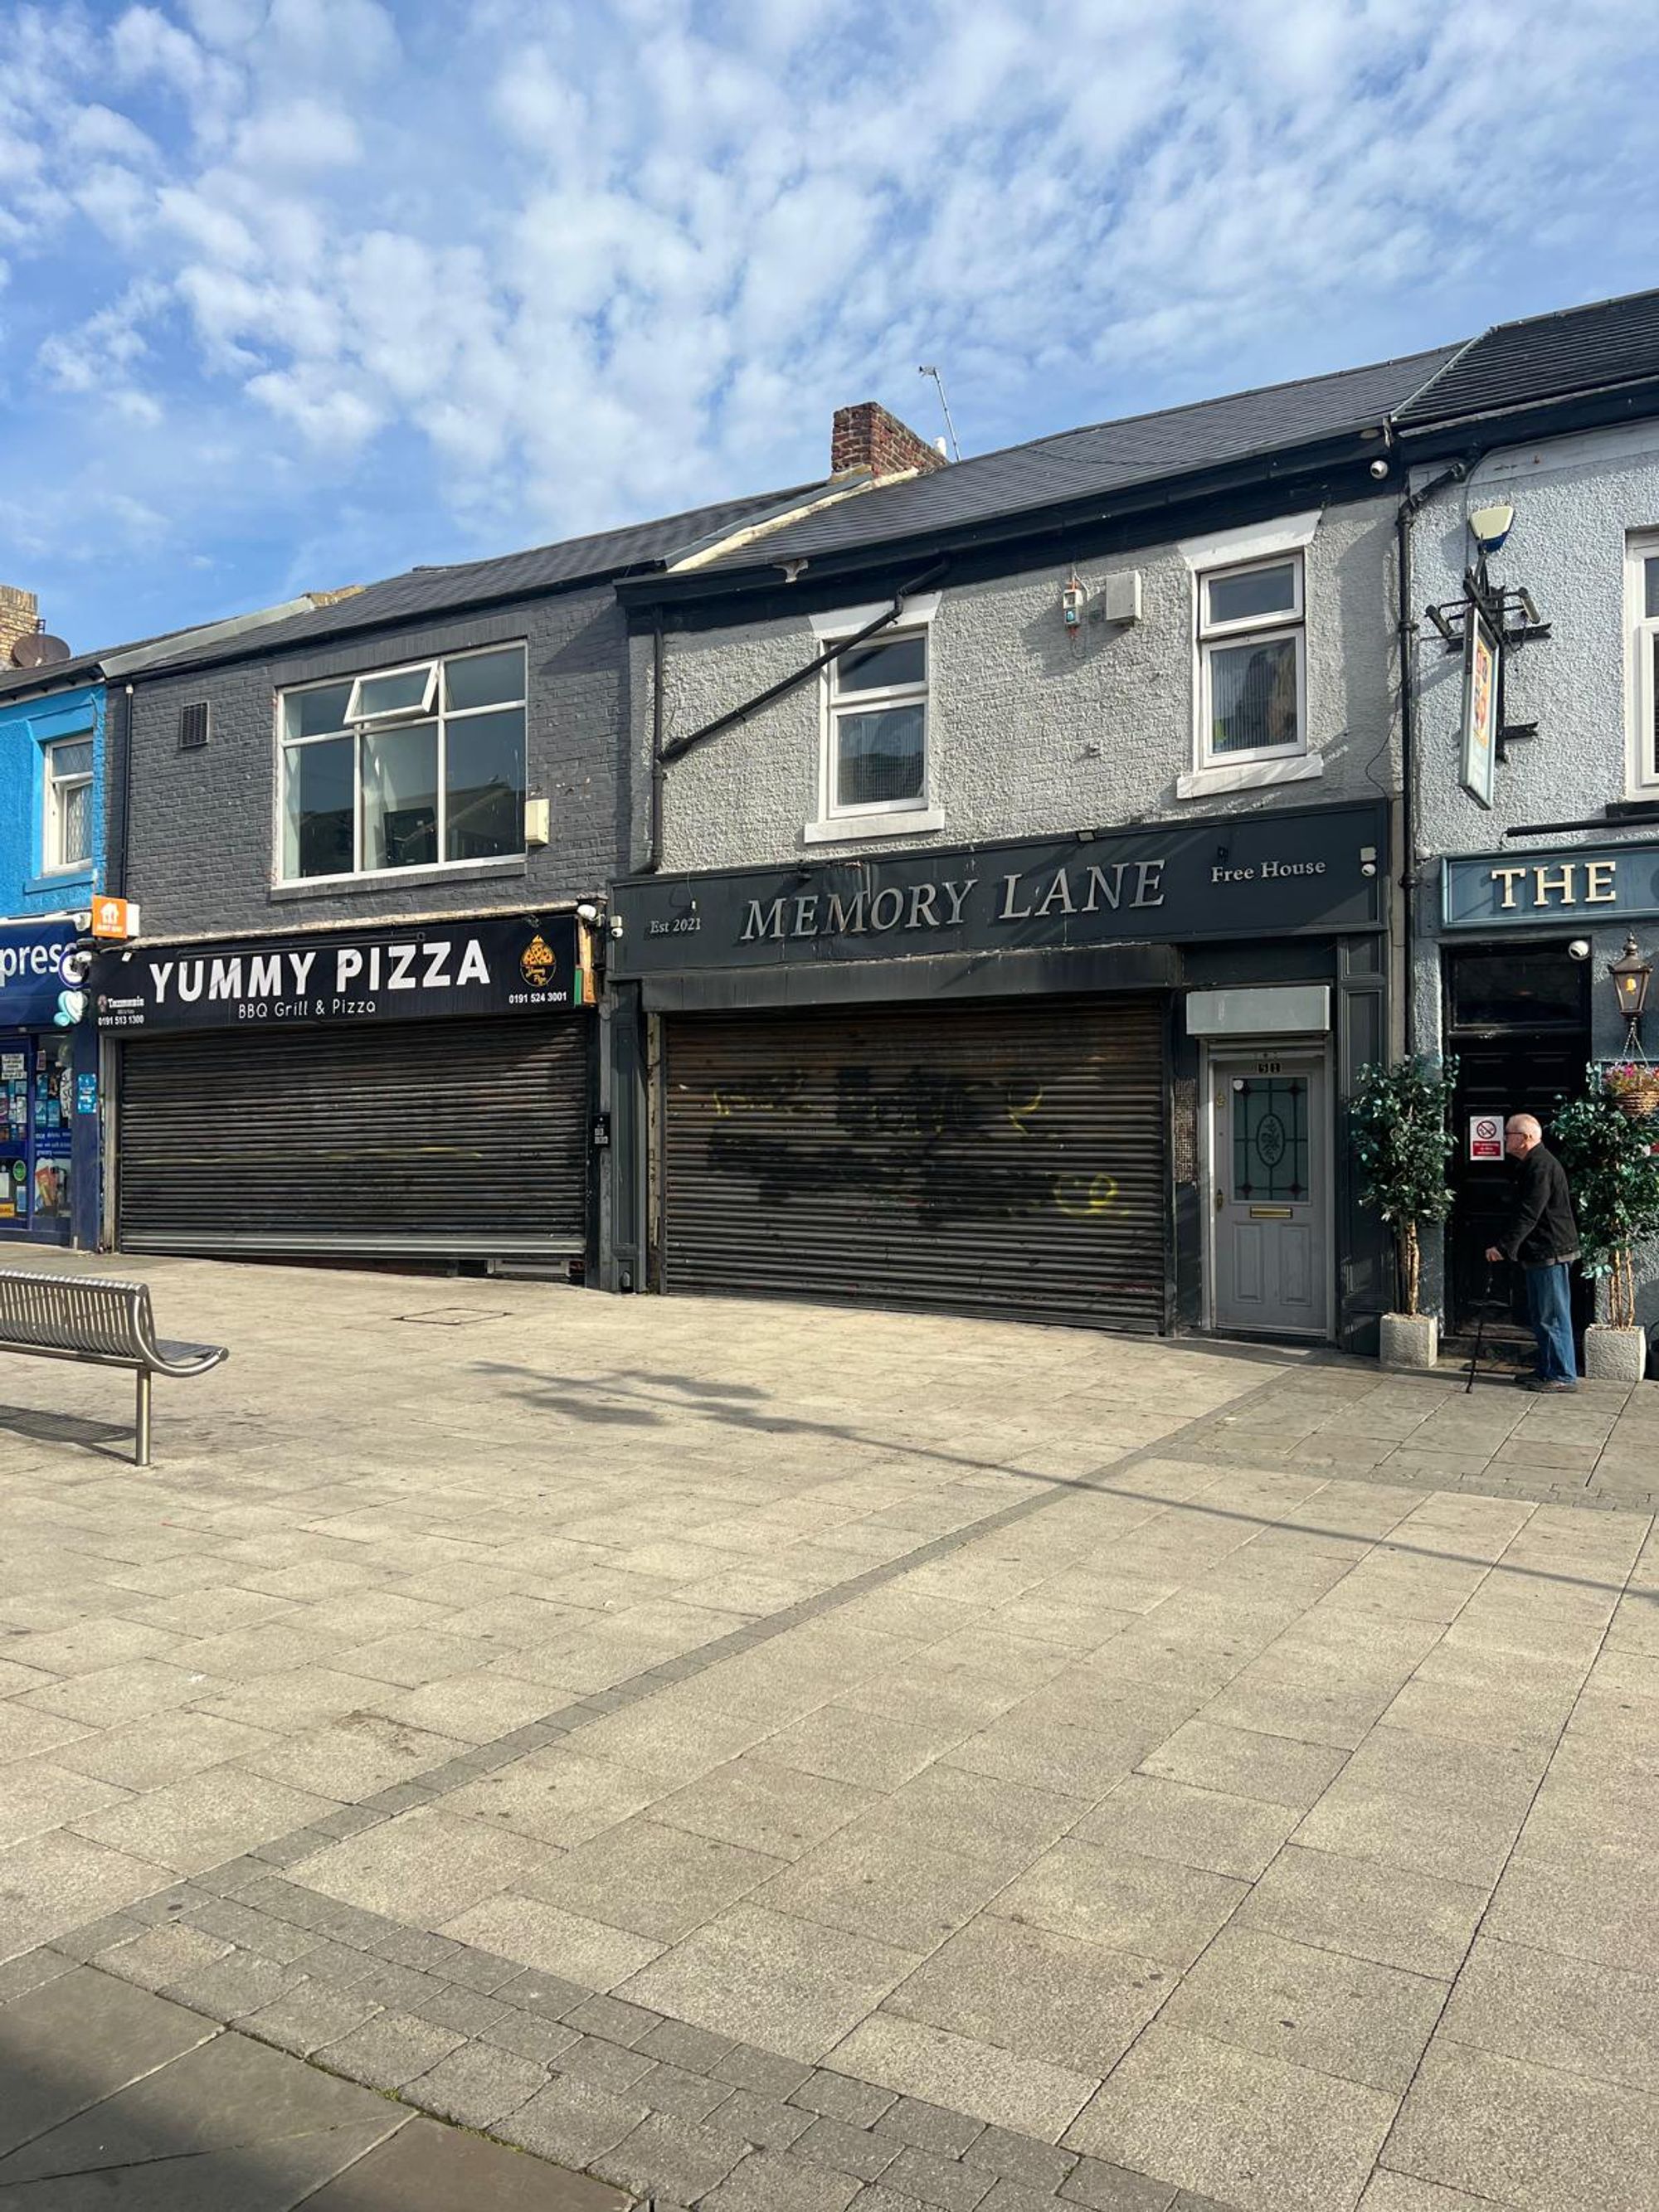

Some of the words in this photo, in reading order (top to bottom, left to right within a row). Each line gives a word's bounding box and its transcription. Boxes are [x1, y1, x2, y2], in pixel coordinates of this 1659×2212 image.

[1211, 866, 1255, 882] Free
[1261, 860, 1326, 878] House
[1491, 861, 1617, 908] THE
[740, 879, 978, 940] MEMORY
[998, 858, 1165, 920] LANE
[649, 920, 669, 934] Est
[673, 917, 701, 931] 2021
[149, 951, 316, 1004] YUMMY
[336, 939, 491, 993] PIZZA
[238, 1002, 269, 1019] BBQ
[274, 1000, 308, 1017] Grill
[315, 999, 325, 1015] &
[333, 998, 377, 1014] Pizza
[508, 994, 528, 1004] 0191
[531, 993, 546, 1003] 524
